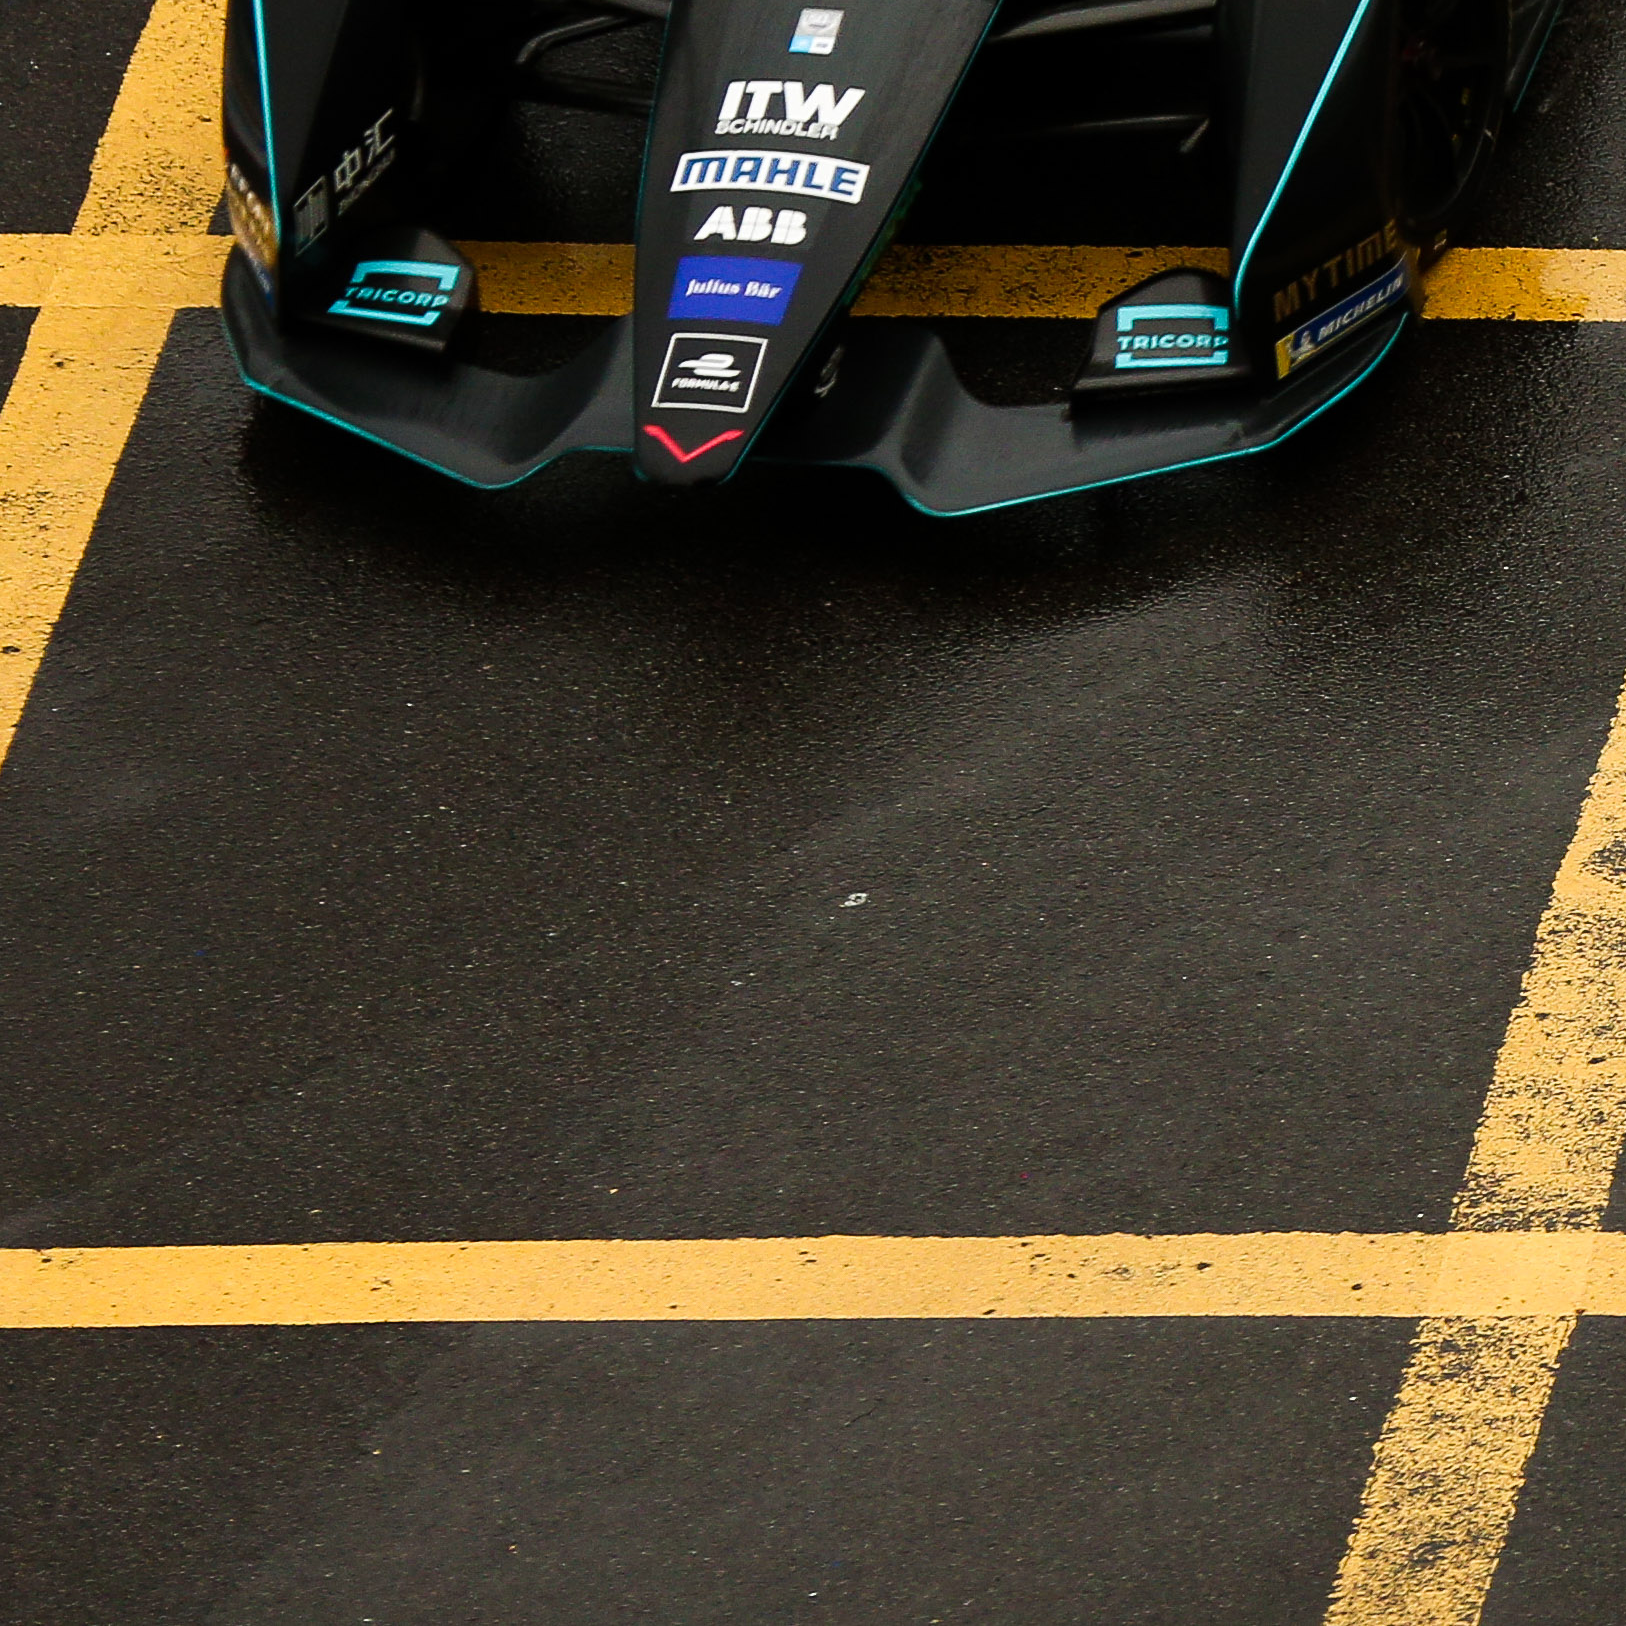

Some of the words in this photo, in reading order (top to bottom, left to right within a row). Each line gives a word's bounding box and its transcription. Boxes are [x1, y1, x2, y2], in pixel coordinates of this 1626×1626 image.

[718, 80, 866, 126] ITW
[715, 118, 839, 141] SCHINDLER
[680, 156, 860, 196] MAHLE
[693, 206, 808, 246] ABB
[344, 286, 450, 308] TRICORP
[685, 278, 742, 297] Julius
[743, 280, 784, 299] Bär
[1316, 272, 1404, 342] MICHELIN
[1116, 333, 1230, 351] TRICORP
